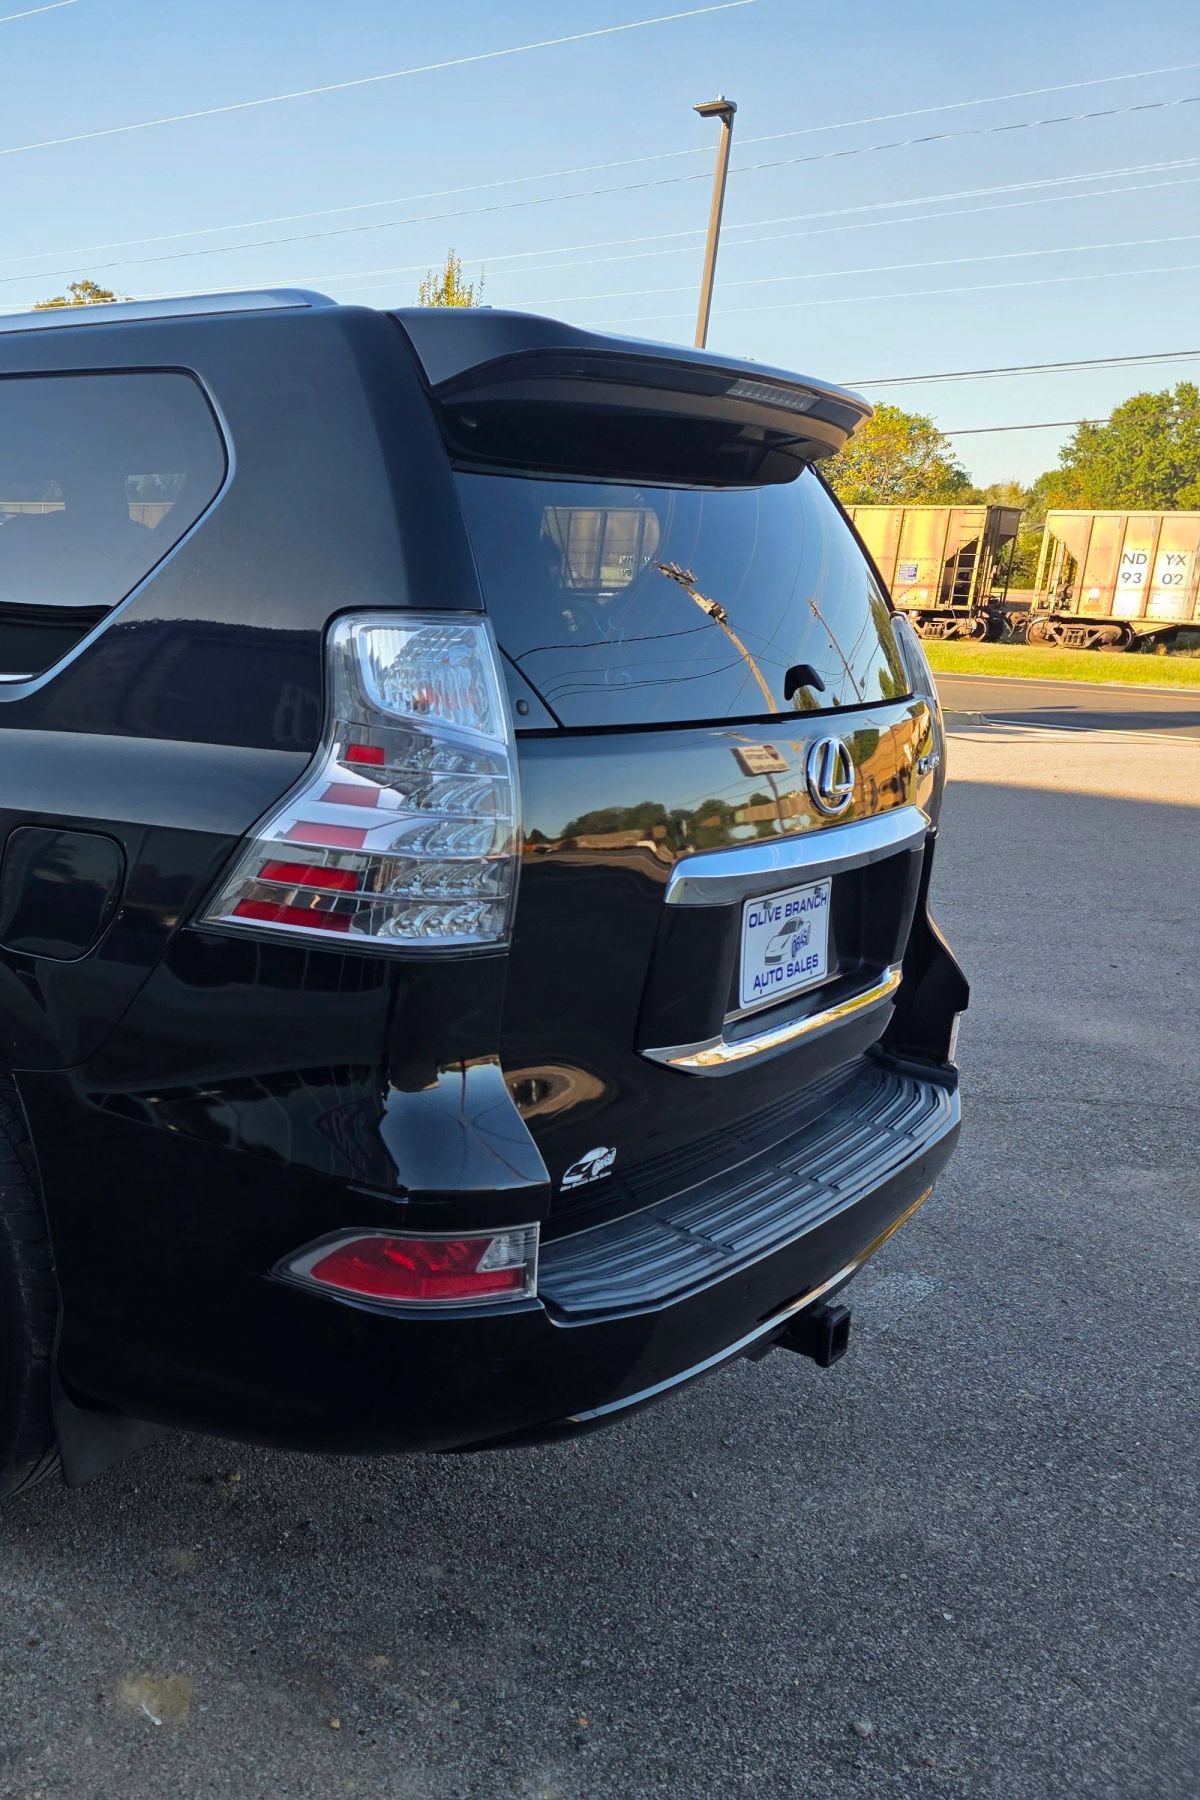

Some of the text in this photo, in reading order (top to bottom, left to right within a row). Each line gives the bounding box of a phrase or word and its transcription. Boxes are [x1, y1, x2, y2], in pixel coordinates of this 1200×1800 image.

[1122, 553, 1187, 566] ND YX
[1121, 572, 1184, 585] 93 02
[748, 892, 828, 929] OLIVE BRANCH
[752, 954, 820, 991] AUTO SALES
